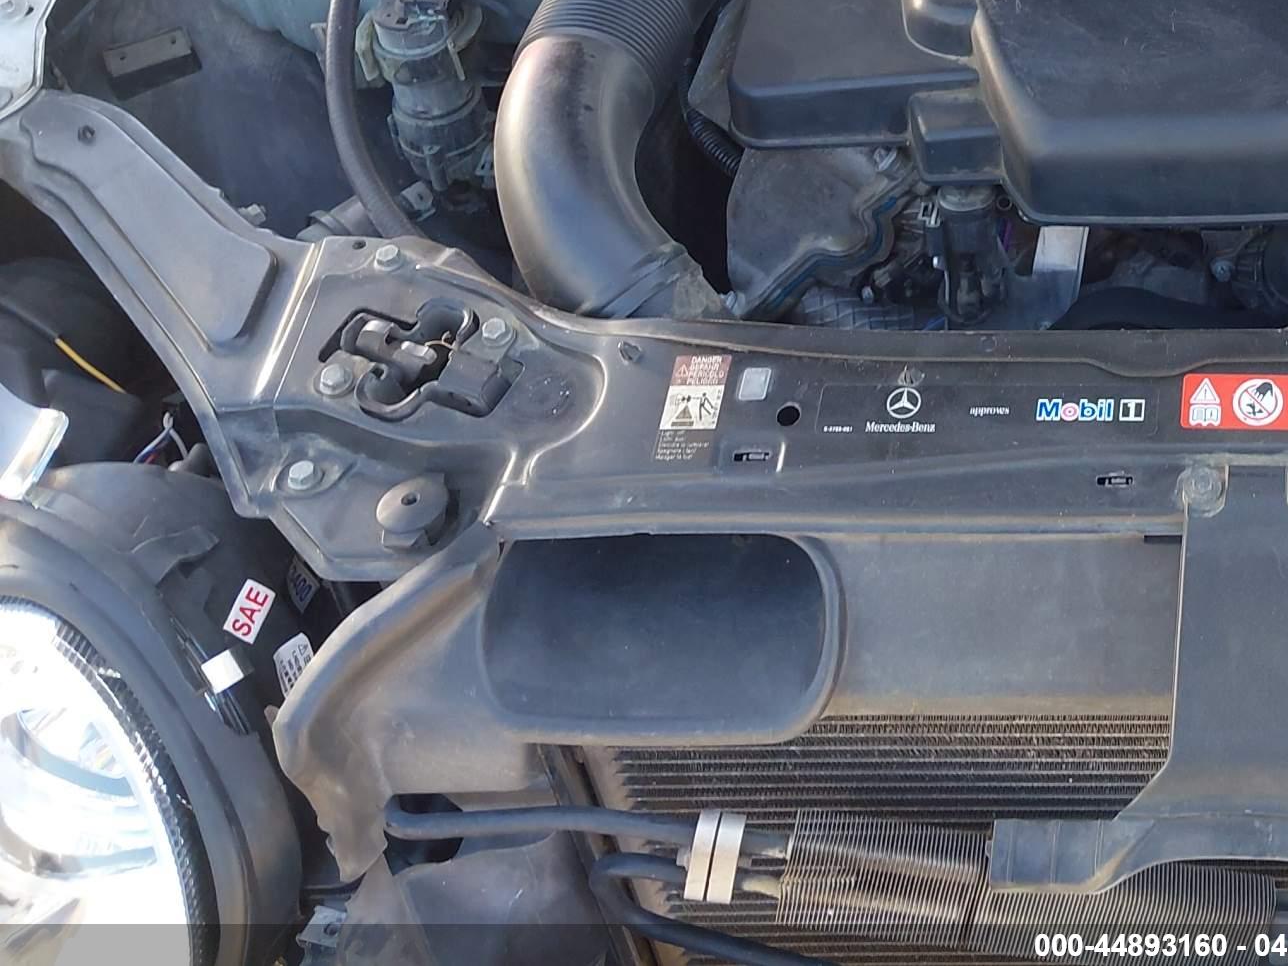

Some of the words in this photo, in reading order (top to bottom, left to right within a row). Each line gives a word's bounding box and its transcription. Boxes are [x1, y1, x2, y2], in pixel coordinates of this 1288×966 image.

[970, 405, 1010, 417] approves
[1036, 398, 1115, 422] Mobil
[865, 421, 936, 433] Mercedes-Benz
[232, 587, 269, 636] SAE
